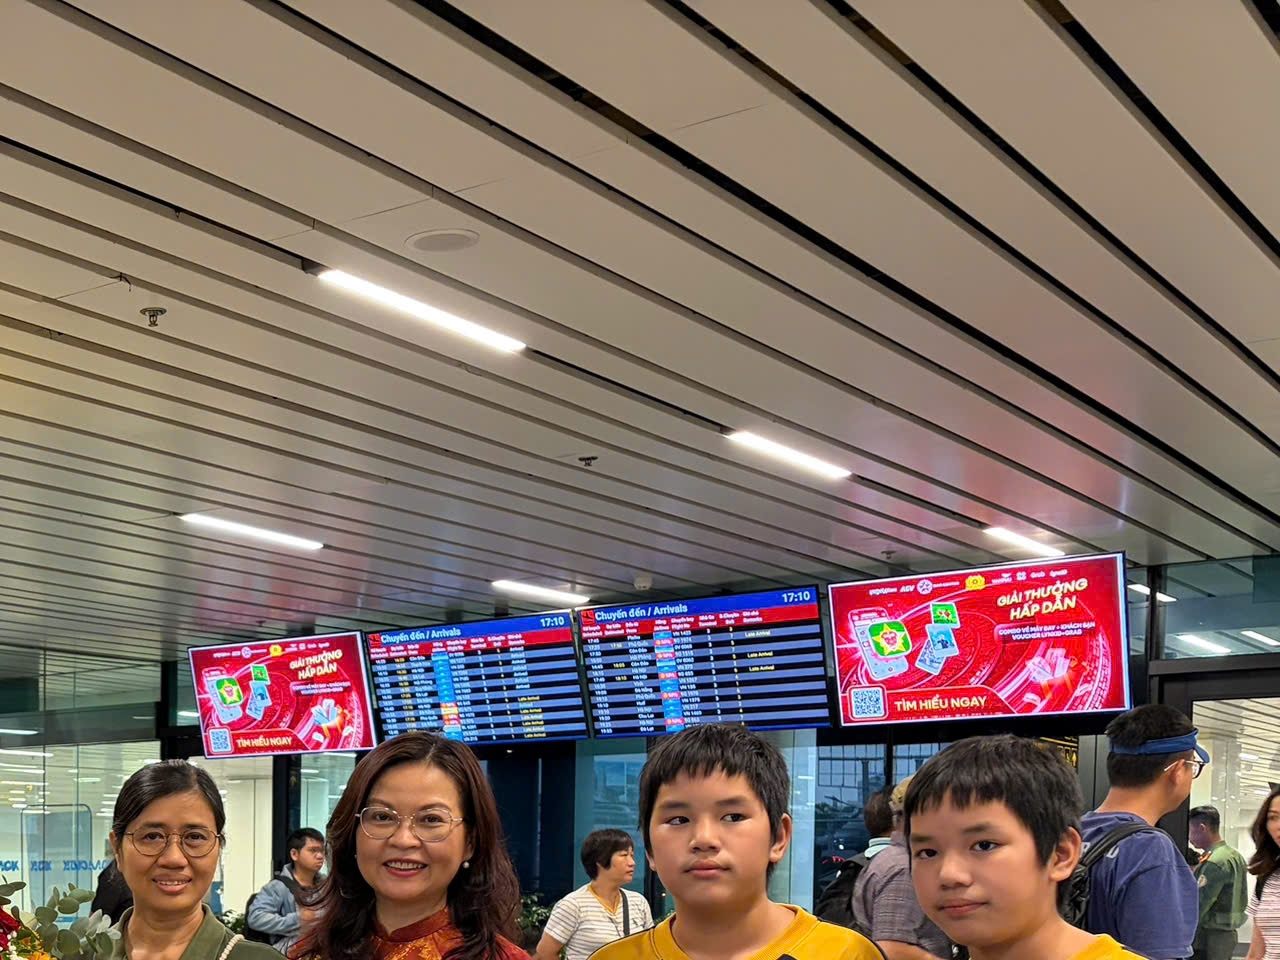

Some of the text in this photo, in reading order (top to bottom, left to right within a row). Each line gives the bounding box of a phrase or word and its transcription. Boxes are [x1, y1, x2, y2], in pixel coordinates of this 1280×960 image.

[781, 590, 810, 603] 17:10
[997, 579, 1088, 606] GIẢI THƯỞNG
[594, 608, 628, 622] Chuyến
[653, 602, 688, 615] Arrivals
[1010, 593, 1077, 620] HẤP DẪN
[539, 616, 564, 627] 17:10
[430, 627, 461, 638] Arrivals
[894, 694, 987, 712] TÌM HIỂU NGAY
[236, 737, 251, 748] TÌM
[271, 737, 292, 746] NGAY
